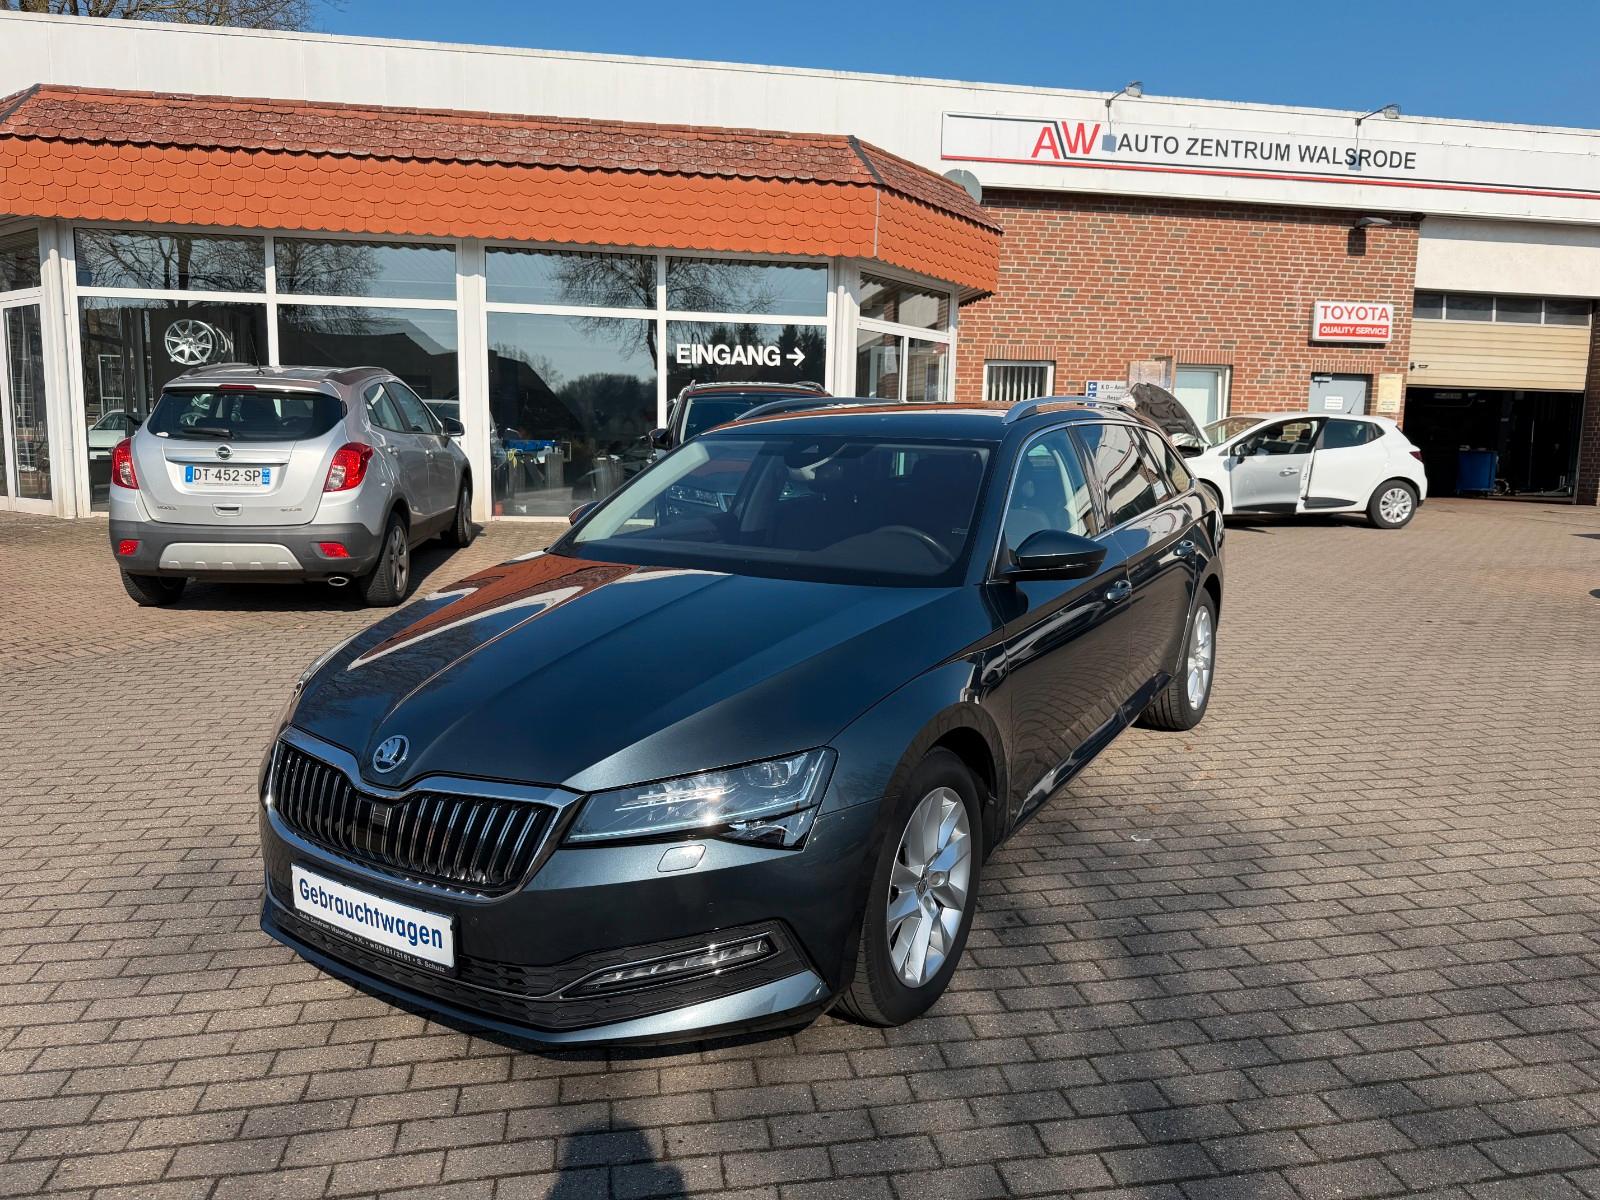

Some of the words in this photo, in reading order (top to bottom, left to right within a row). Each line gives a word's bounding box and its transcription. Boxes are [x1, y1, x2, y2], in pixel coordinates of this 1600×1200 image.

[1031, 121, 1101, 160] AW
[1117, 133, 1179, 155] AUTO
[1185, 137, 1291, 162] ZENTRUM
[1298, 144, 1417, 170] WALSRODE
[1320, 305, 1390, 322] TOYOTA
[1321, 325, 1356, 334] QUALITY
[1356, 326, 1387, 335] SERVICE
[676, 343, 781, 367] EINGANG
[193, 468, 261, 482] DT-452-SP
[299, 878, 443, 949] Gebrauchtwagen
